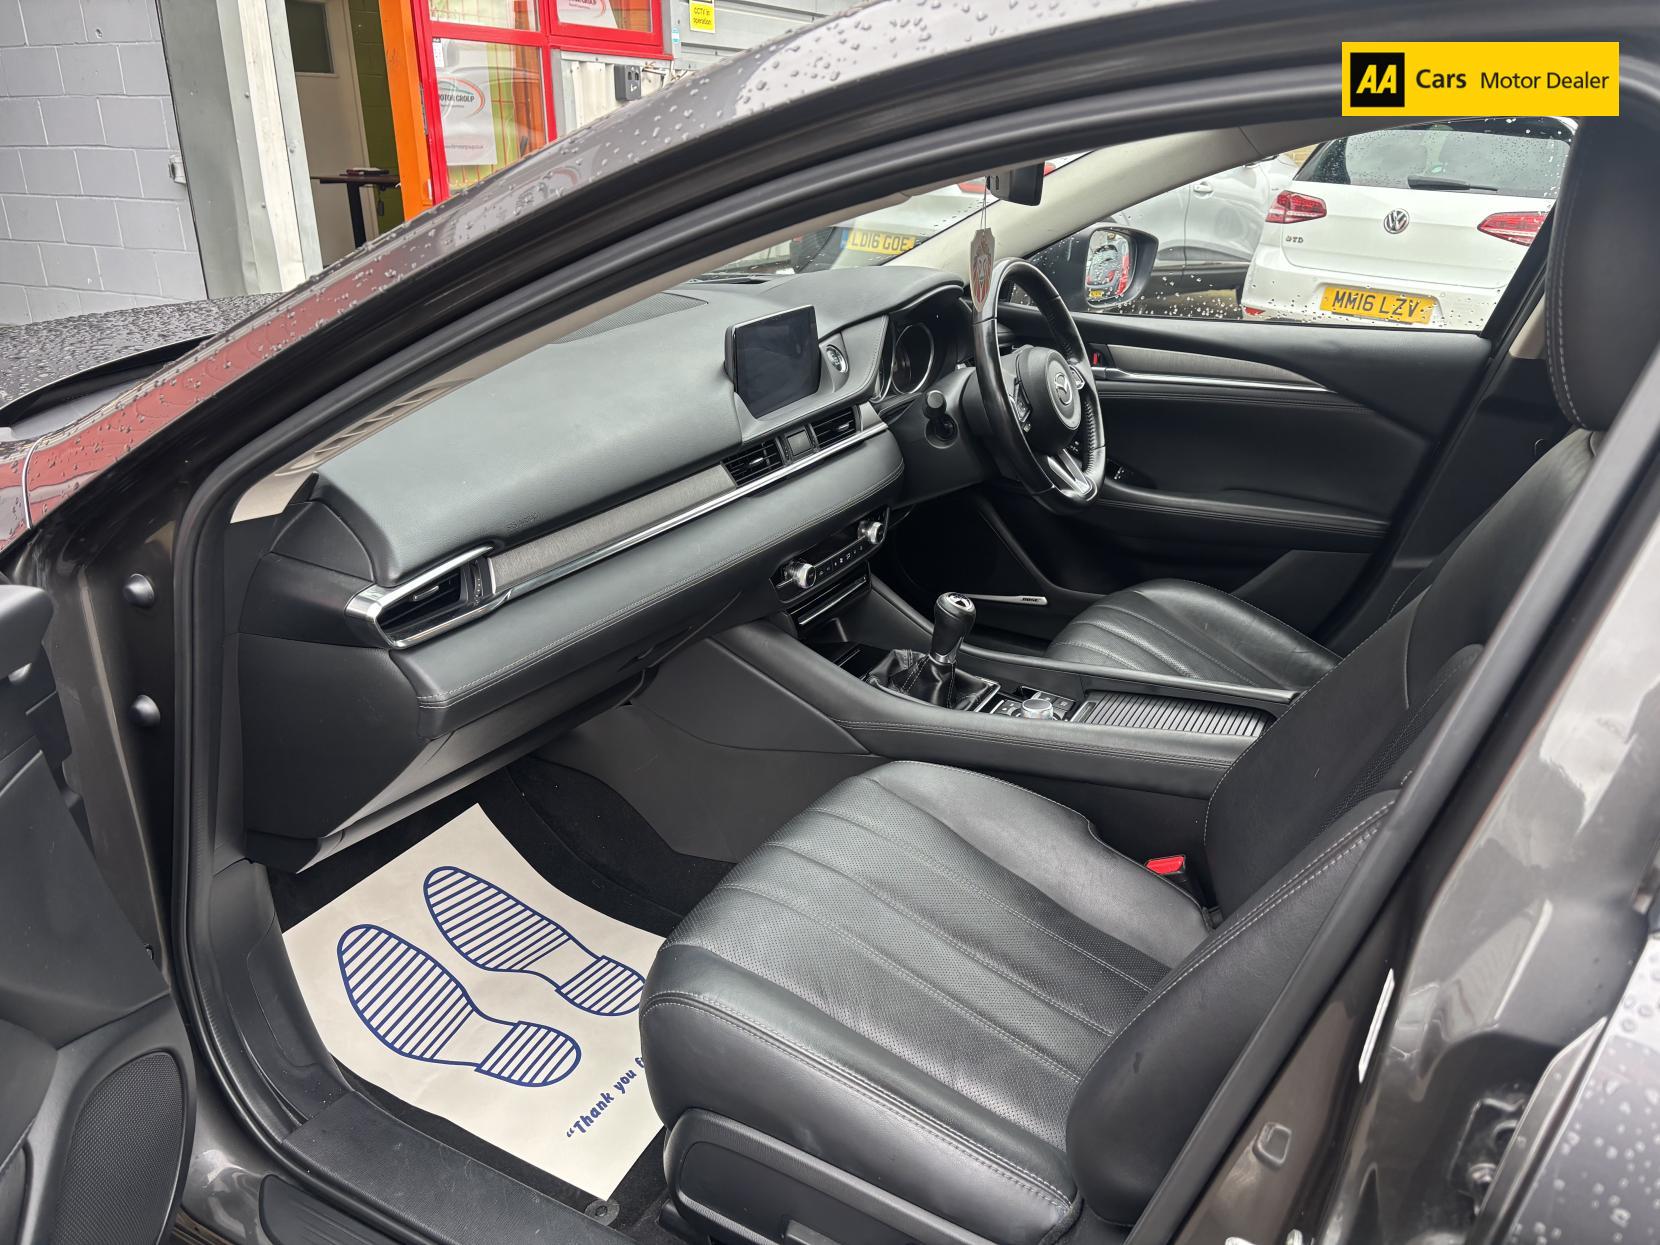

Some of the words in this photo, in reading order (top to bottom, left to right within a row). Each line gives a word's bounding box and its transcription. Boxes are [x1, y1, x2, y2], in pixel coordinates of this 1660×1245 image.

[438, 93, 455, 102] OTOR
[851, 230, 880, 249] LD16
[882, 234, 910, 252] GOE
[1332, 289, 1376, 312] MM16
[1378, 296, 1420, 318] LZV
[613, 1069, 637, 1094] you
